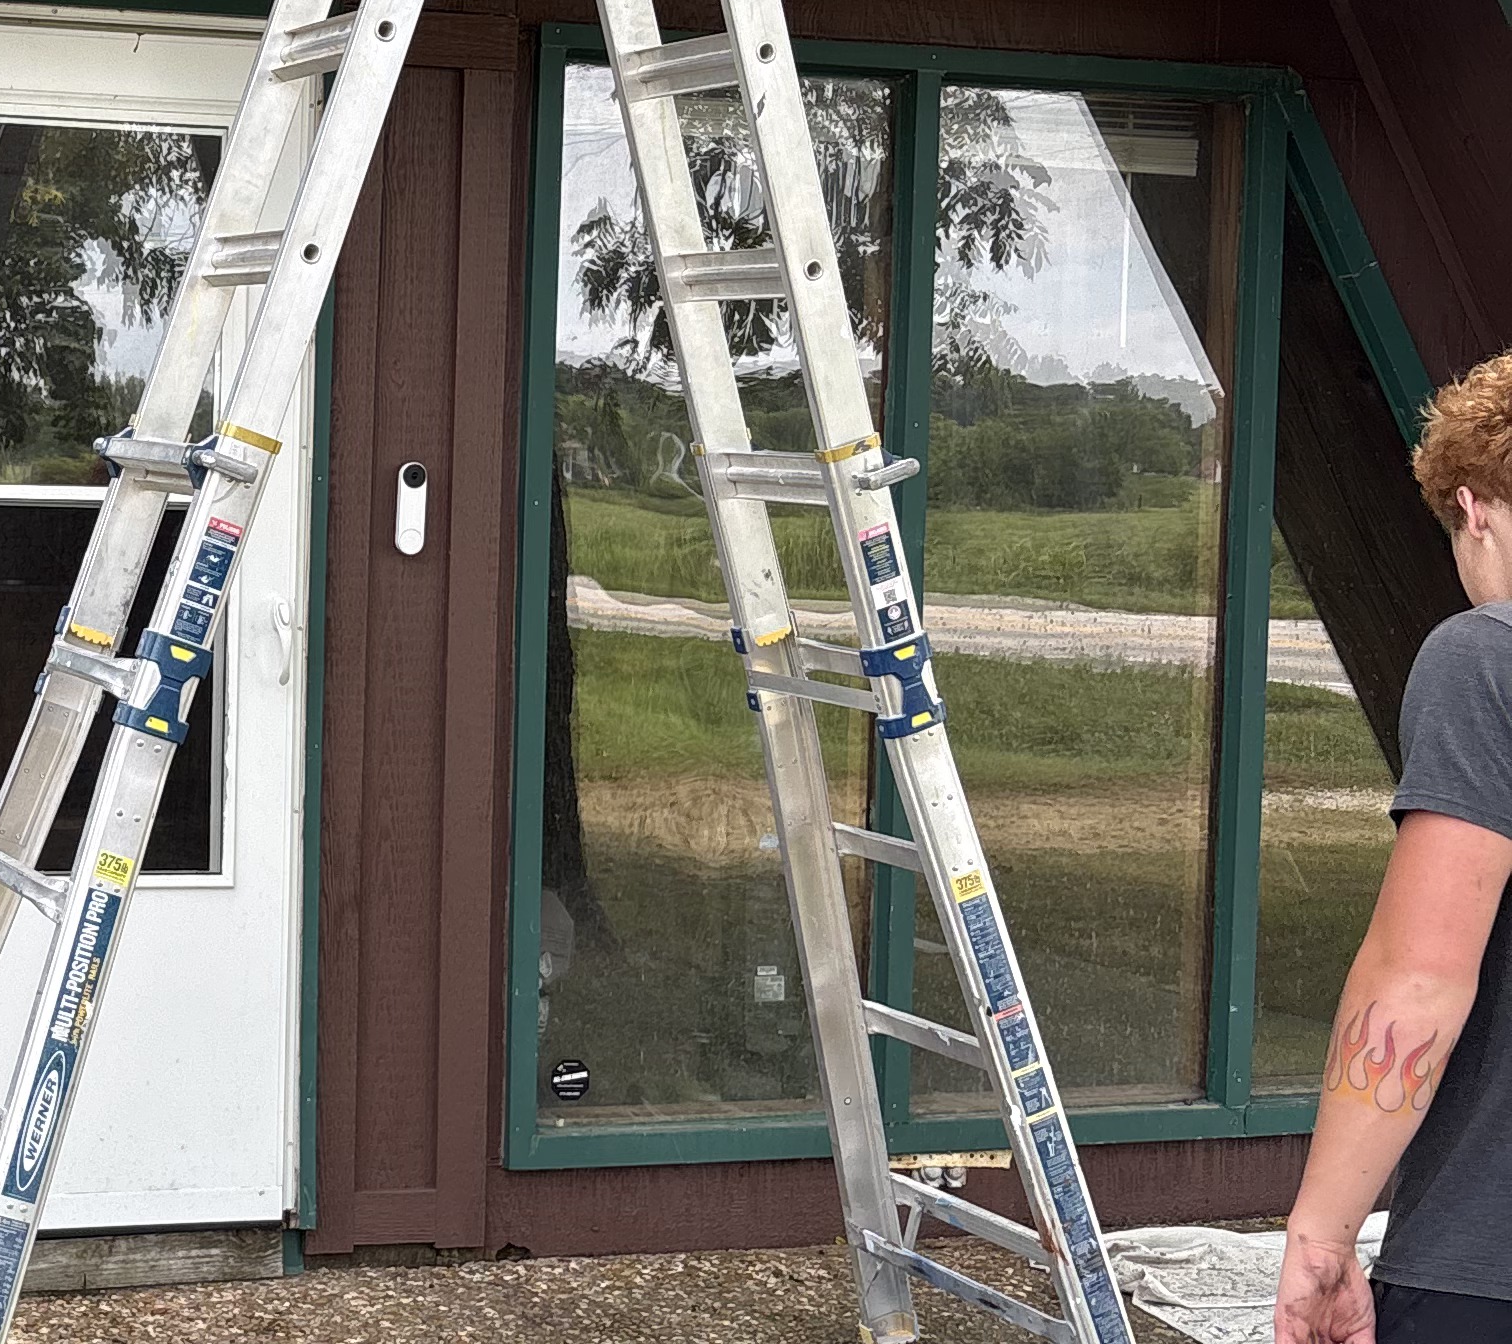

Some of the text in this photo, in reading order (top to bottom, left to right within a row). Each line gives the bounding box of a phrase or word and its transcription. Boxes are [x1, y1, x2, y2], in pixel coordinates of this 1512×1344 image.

[50, 890, 109, 1043] MULTI-POSITION PRO
[88, 956, 101, 981] RAILS
[25, 1077, 57, 1161] WERNER
